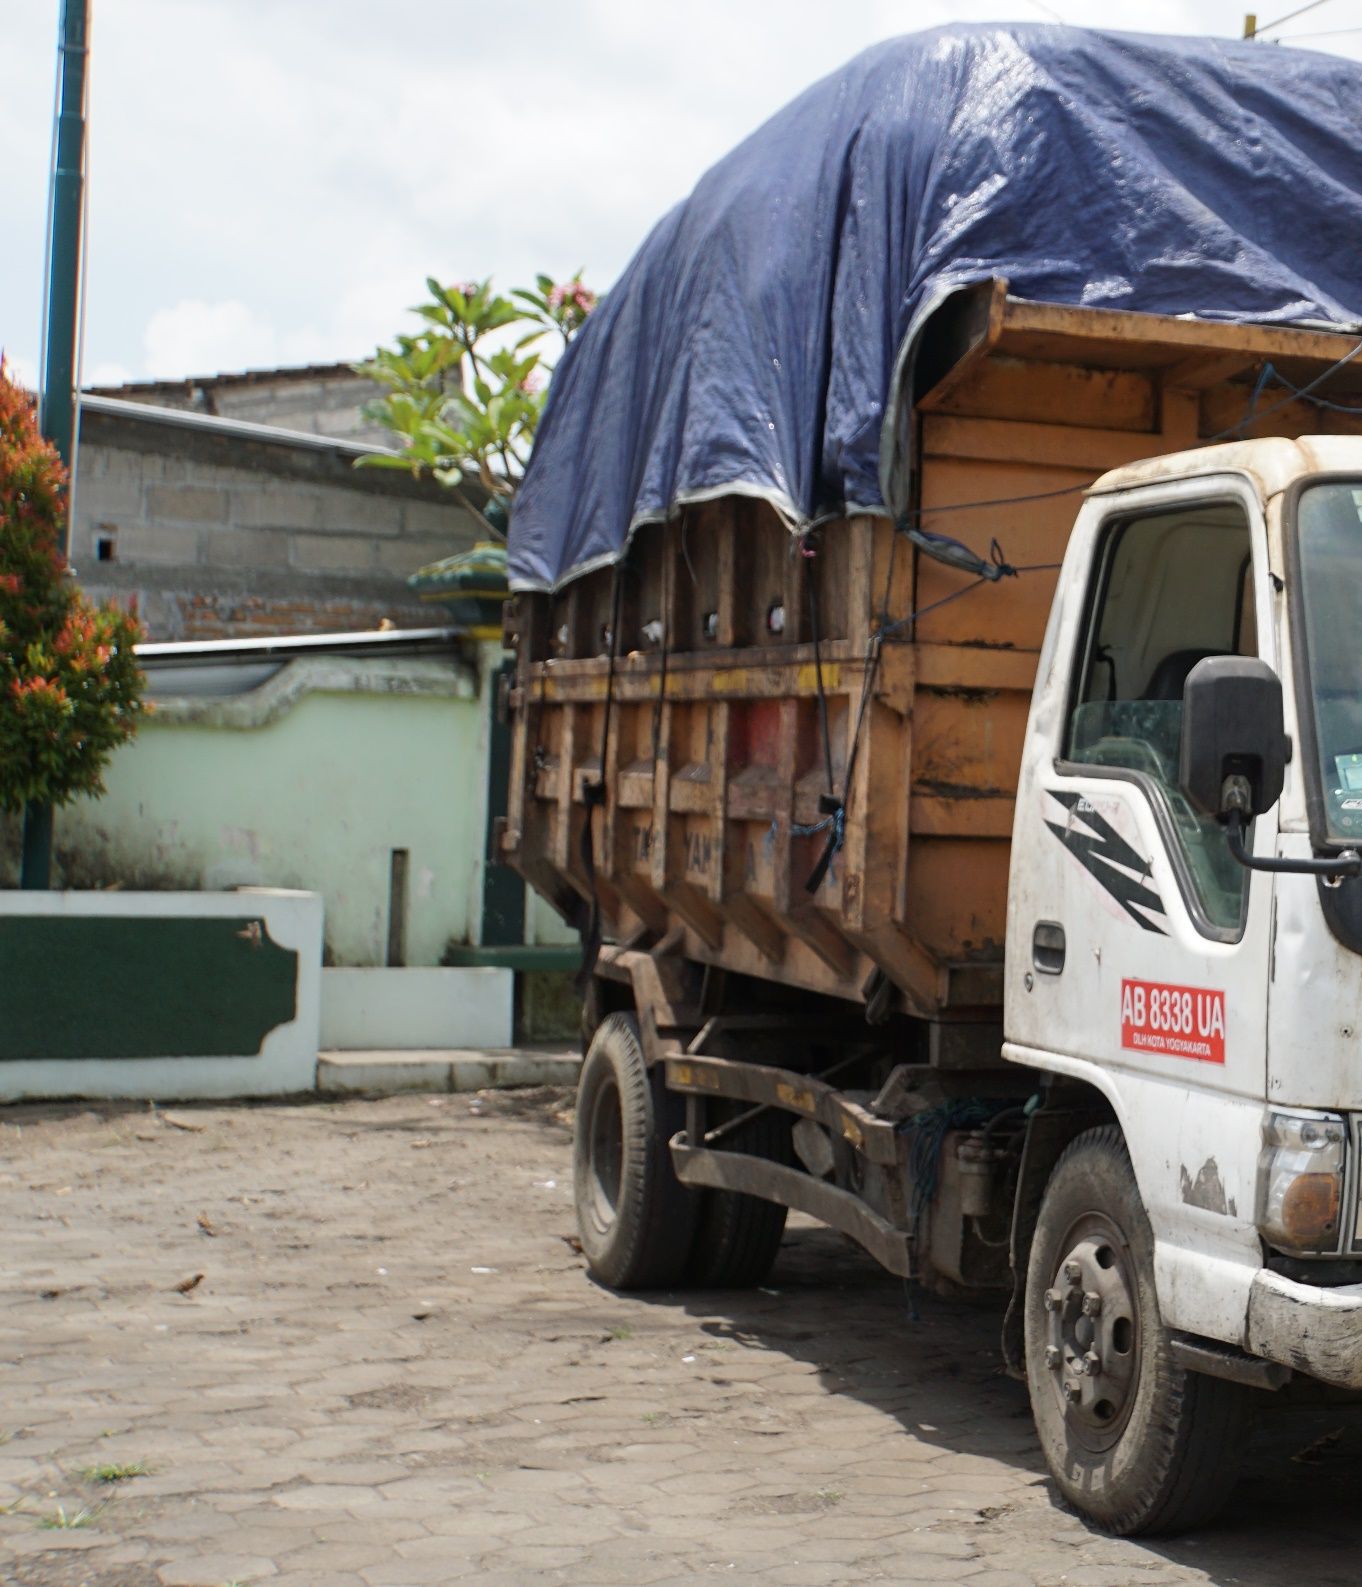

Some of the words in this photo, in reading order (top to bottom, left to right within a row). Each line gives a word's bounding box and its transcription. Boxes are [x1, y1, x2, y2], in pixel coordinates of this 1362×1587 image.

[1121, 984, 1146, 1027] AB
[1149, 988, 1193, 1034] 8338
[1197, 993, 1224, 1040] UA
[1132, 1032, 1147, 1045] DLH
[1147, 1034, 1165, 1048] KOTA
[1165, 1037, 1211, 1056] YOGYAKARTA
